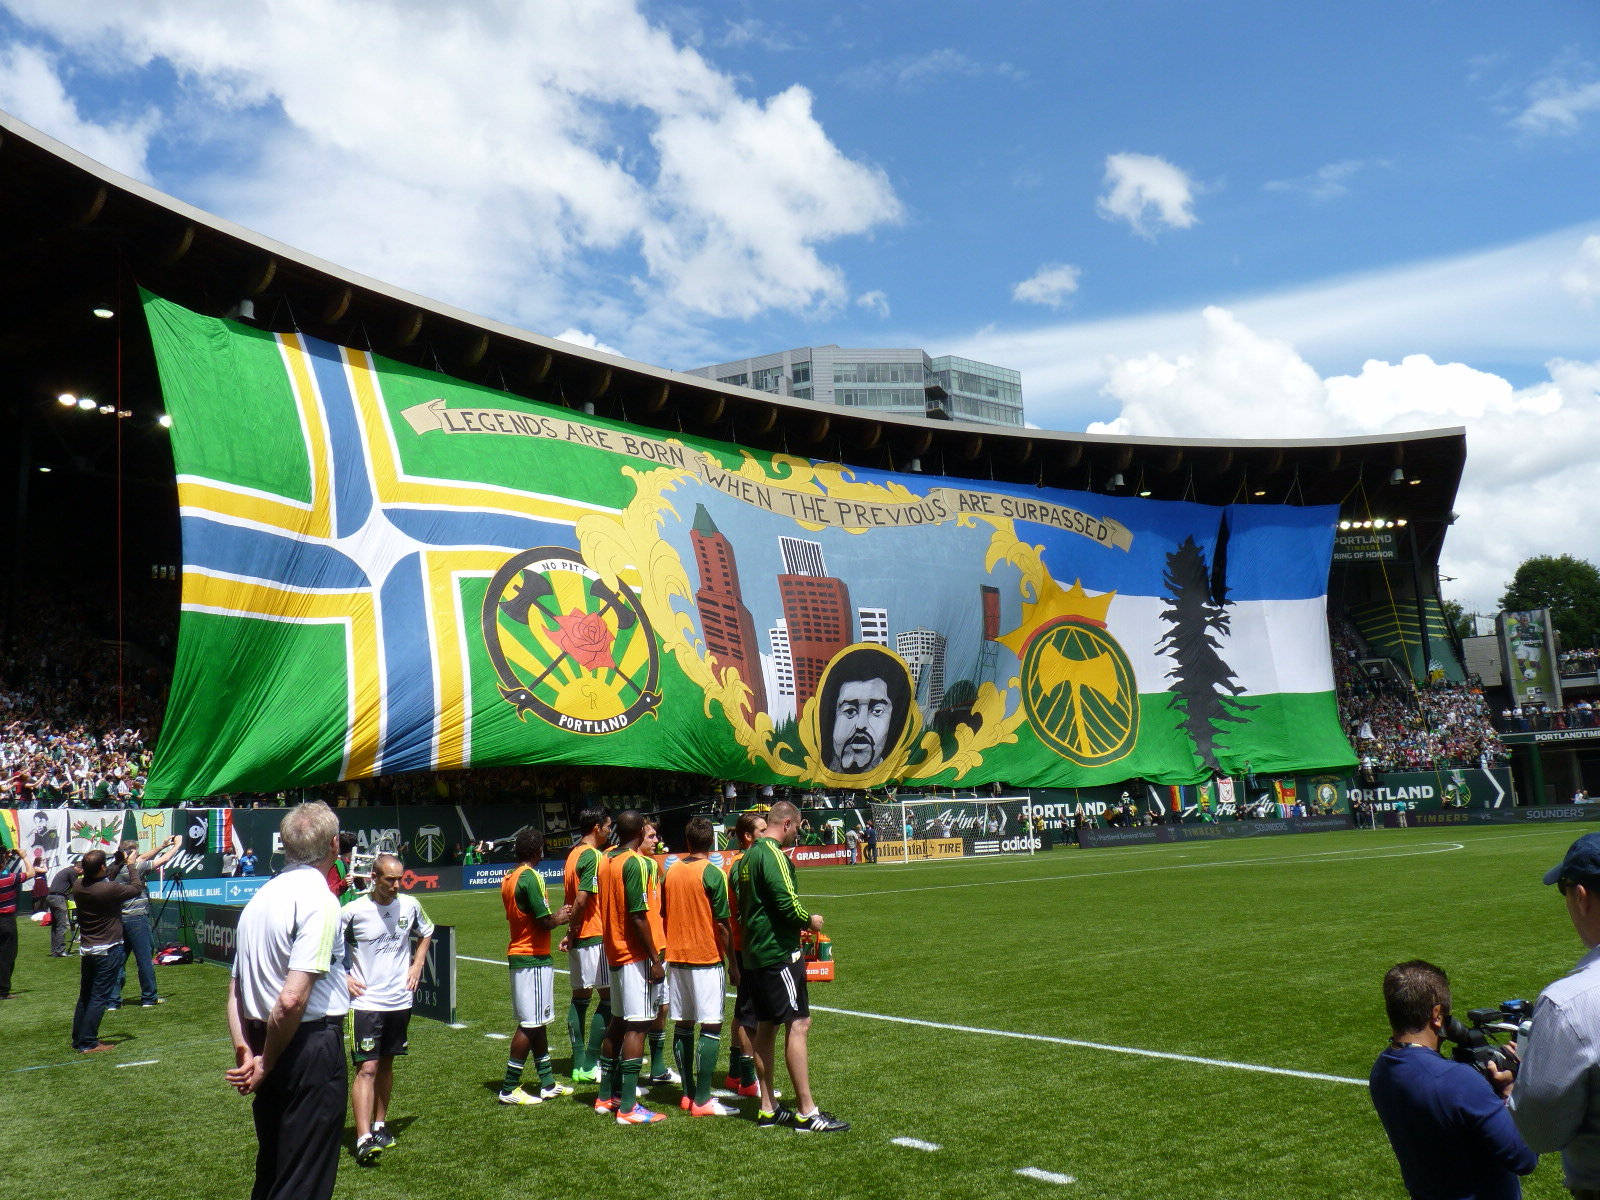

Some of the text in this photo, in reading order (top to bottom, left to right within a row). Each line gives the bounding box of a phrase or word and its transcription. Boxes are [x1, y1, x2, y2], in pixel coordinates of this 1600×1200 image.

[443, 411, 686, 468] LEGENDS ARE BORN
[702, 463, 1109, 542] WHEN THE PREVIOUS ARE SURPASSED
[1354, 551, 1364, 559] OF
[542, 561, 588, 575] NO PITY
[558, 714, 628, 733] PORTLAND
[1022, 801, 1107, 818] PORTLAND
[1526, 808, 1584, 819] SOUNDERS
[938, 843, 961, 854] TIRE
[796, 851, 820, 861] GRAB
